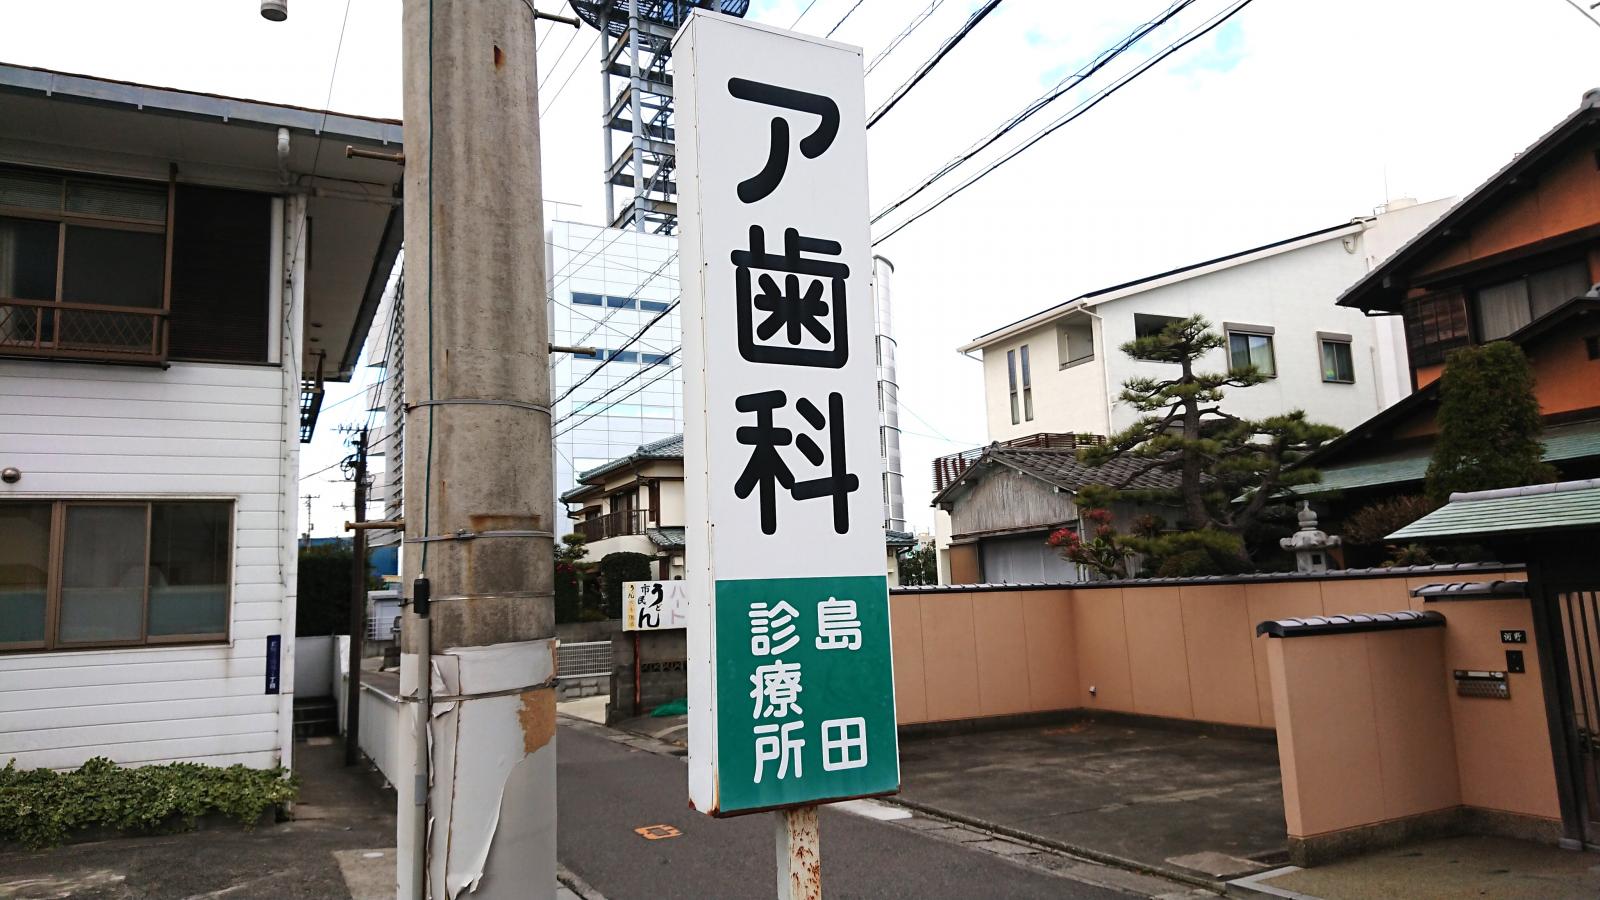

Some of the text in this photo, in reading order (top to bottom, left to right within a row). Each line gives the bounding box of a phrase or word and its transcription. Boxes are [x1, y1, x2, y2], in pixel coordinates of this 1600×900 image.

[728, 77, 859, 535] ア歯科
[749, 600, 807, 784] 診療所
[815, 597, 868, 772] 島田
